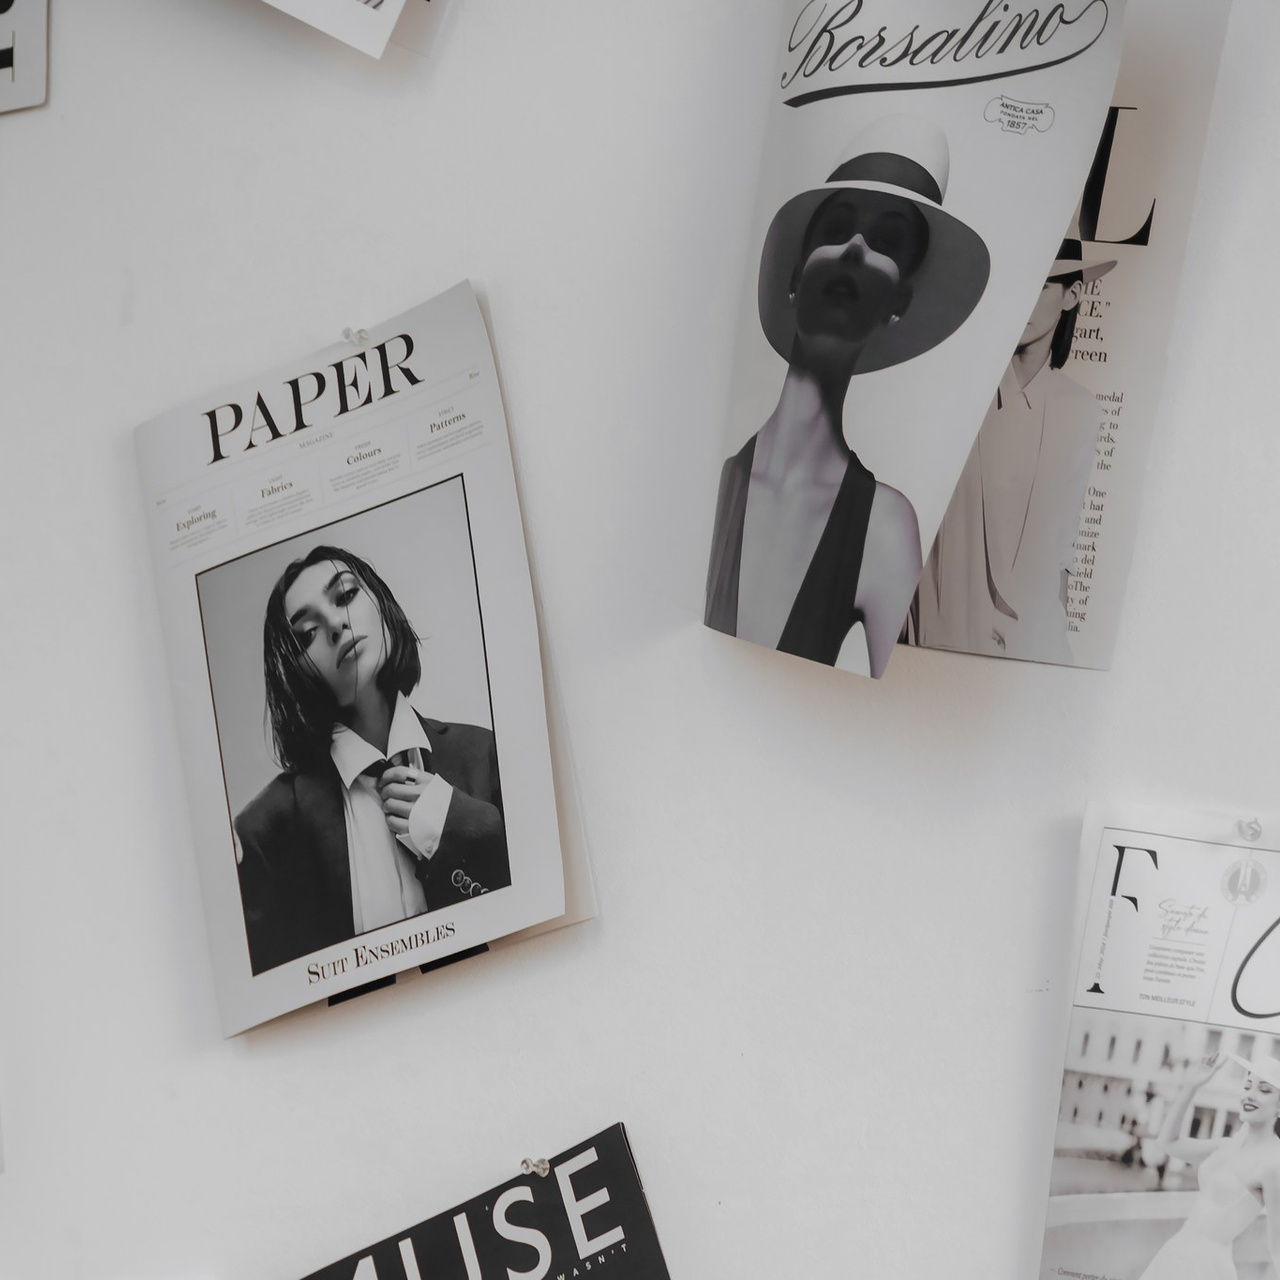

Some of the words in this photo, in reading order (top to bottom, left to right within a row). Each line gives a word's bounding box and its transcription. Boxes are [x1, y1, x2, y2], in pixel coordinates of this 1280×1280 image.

[781, 0, 1109, 90] Borsalino
[1000, 102, 1024, 114] ANTICA
[1006, 119, 1027, 130] 1857
[201, 331, 425, 465] PAPER
[430, 413, 466, 433] Patterns
[346, 447, 382, 465] Colours
[261, 481, 294, 498] Fabrics
[1088, 486, 1107, 499] One
[1090, 500, 1104, 512] hat
[176, 509, 217, 532] Exploring
[1084, 514, 1102, 525] and
[1081, 554, 1095, 566] del
